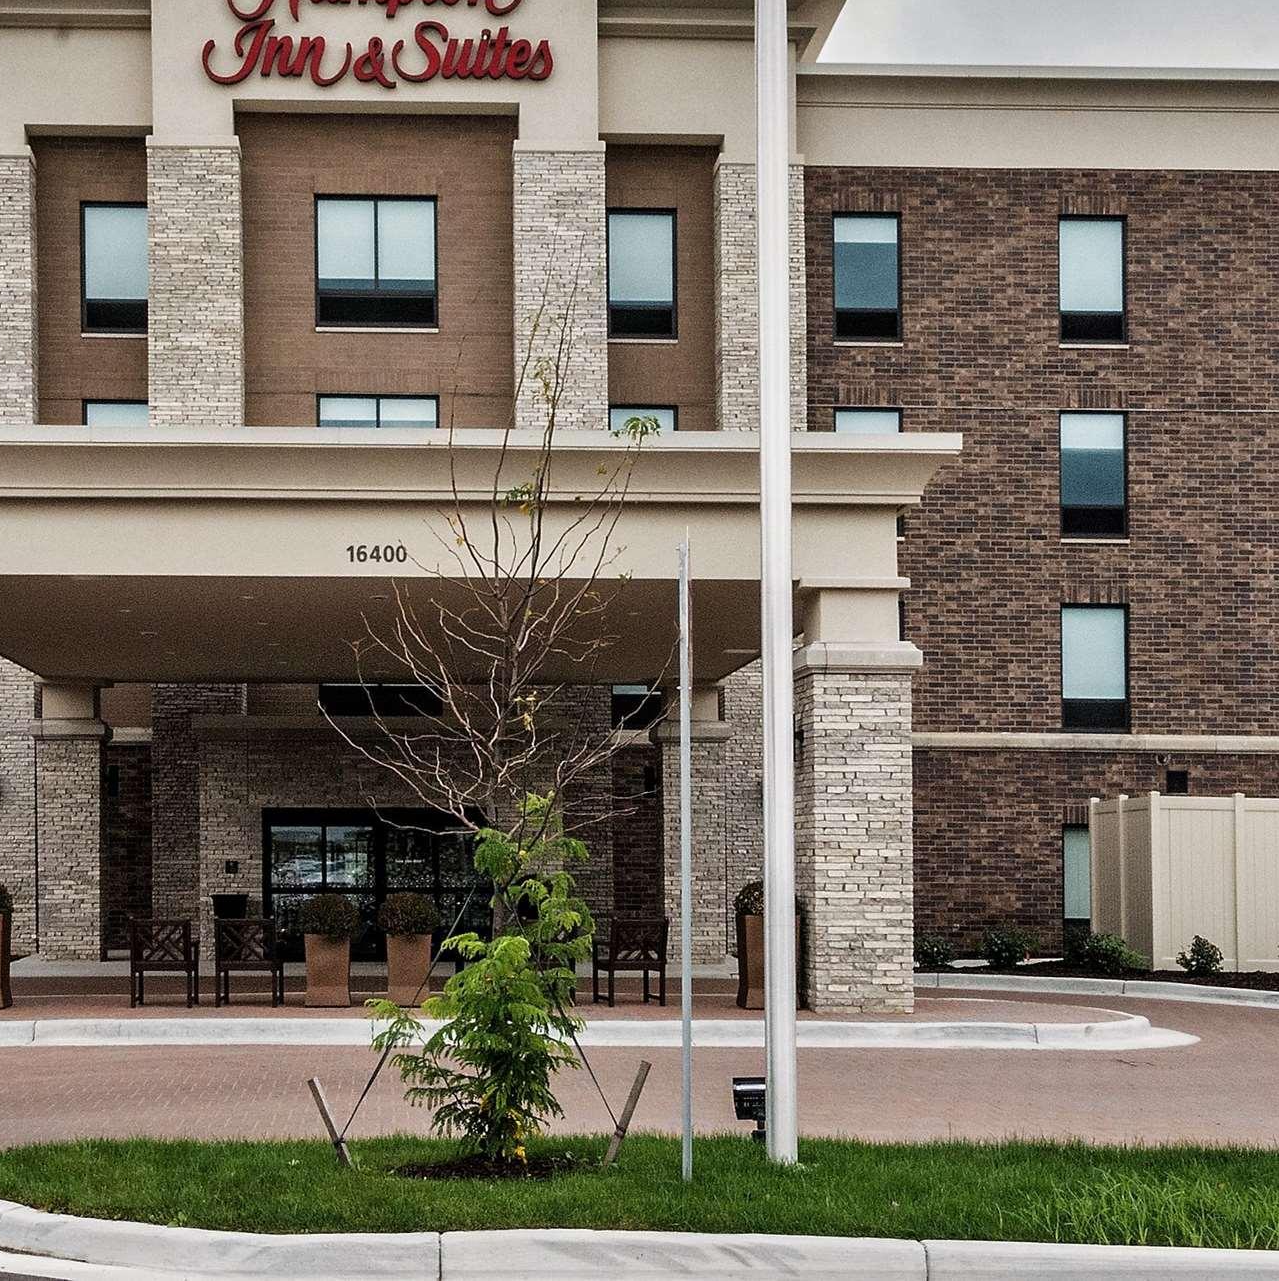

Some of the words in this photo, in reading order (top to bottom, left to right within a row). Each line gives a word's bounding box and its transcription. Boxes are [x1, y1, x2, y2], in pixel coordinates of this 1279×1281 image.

[202, 19, 352, 87] Inn
[353, 36, 397, 89] &
[392, 20, 554, 82] Suites
[346, 545, 408, 563] 16400
